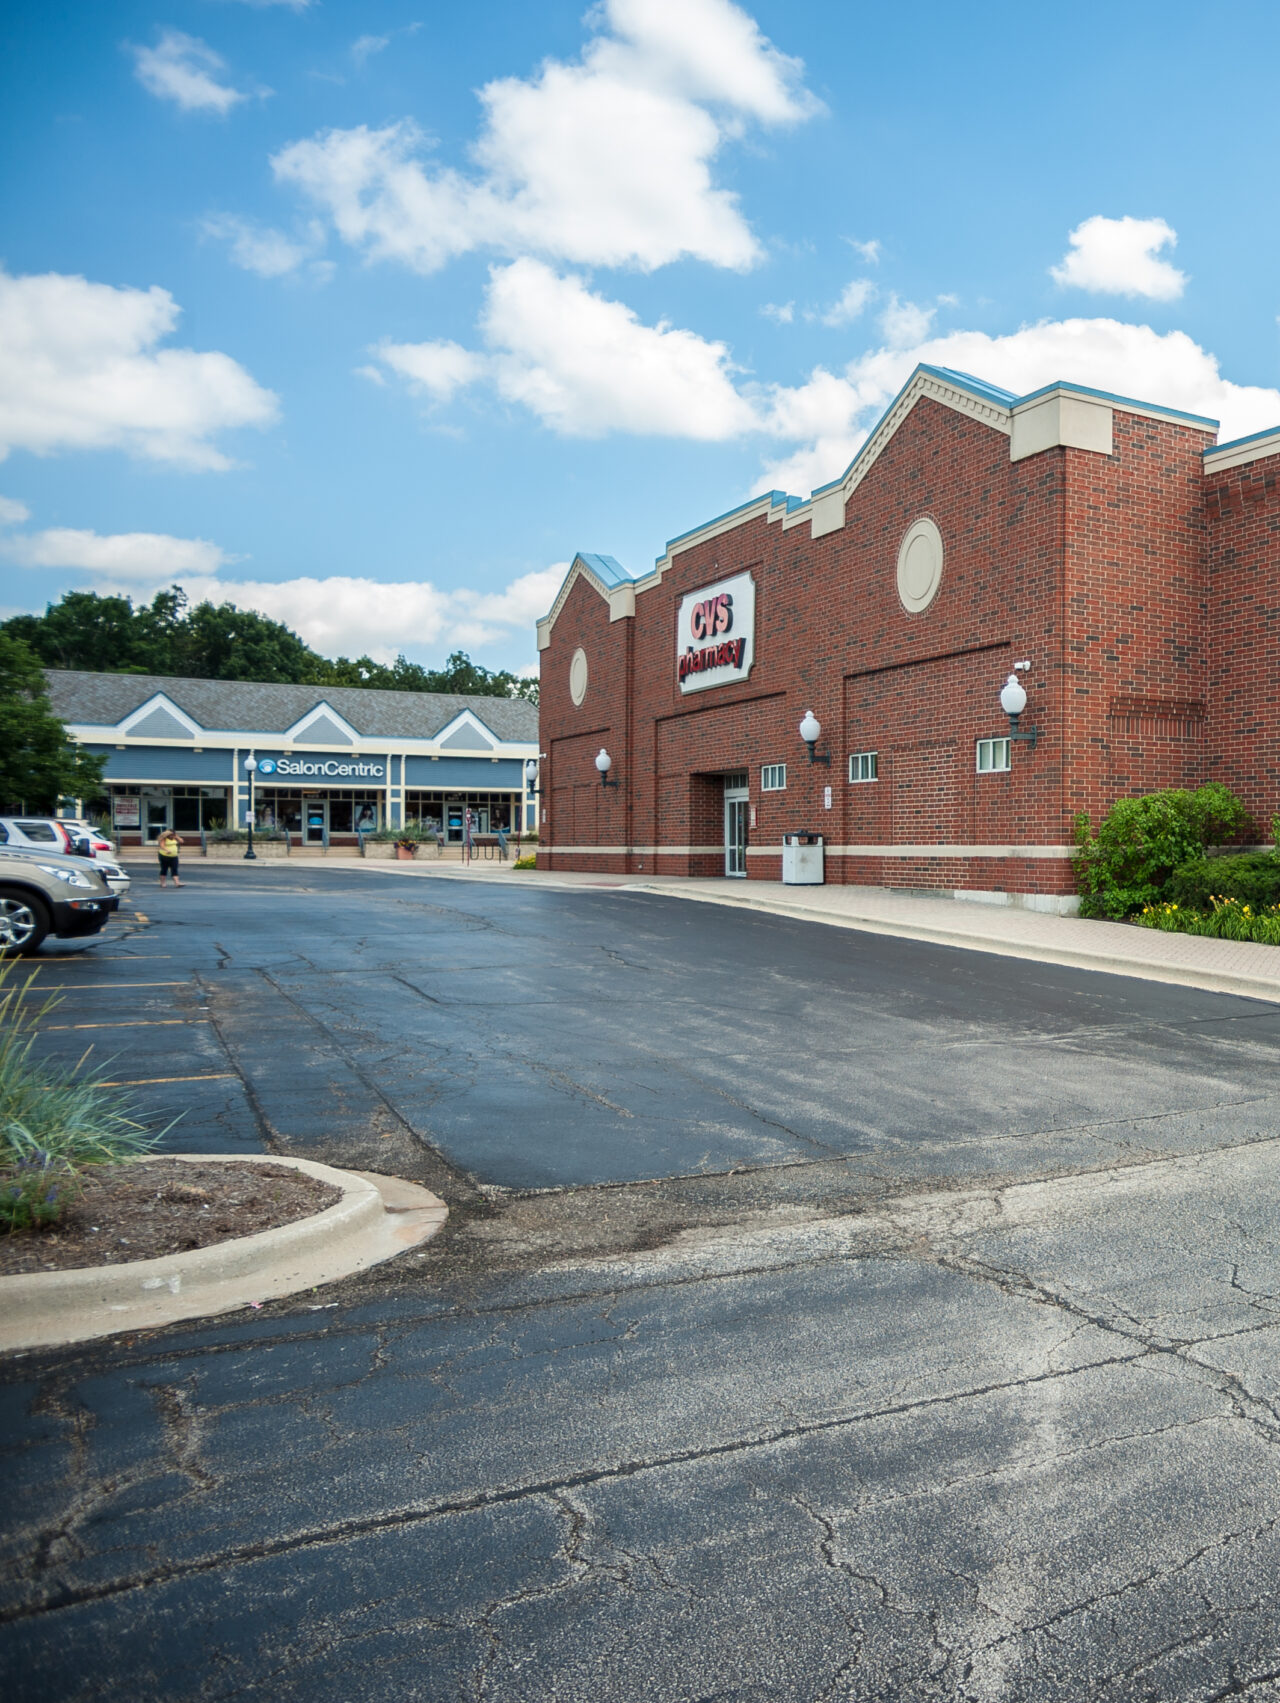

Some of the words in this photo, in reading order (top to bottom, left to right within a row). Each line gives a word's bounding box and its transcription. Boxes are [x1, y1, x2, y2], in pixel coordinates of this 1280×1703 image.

[691, 593, 733, 640] CVS
[678, 637, 747, 683] pharmacy
[276, 759, 384, 776] SalonCentric
